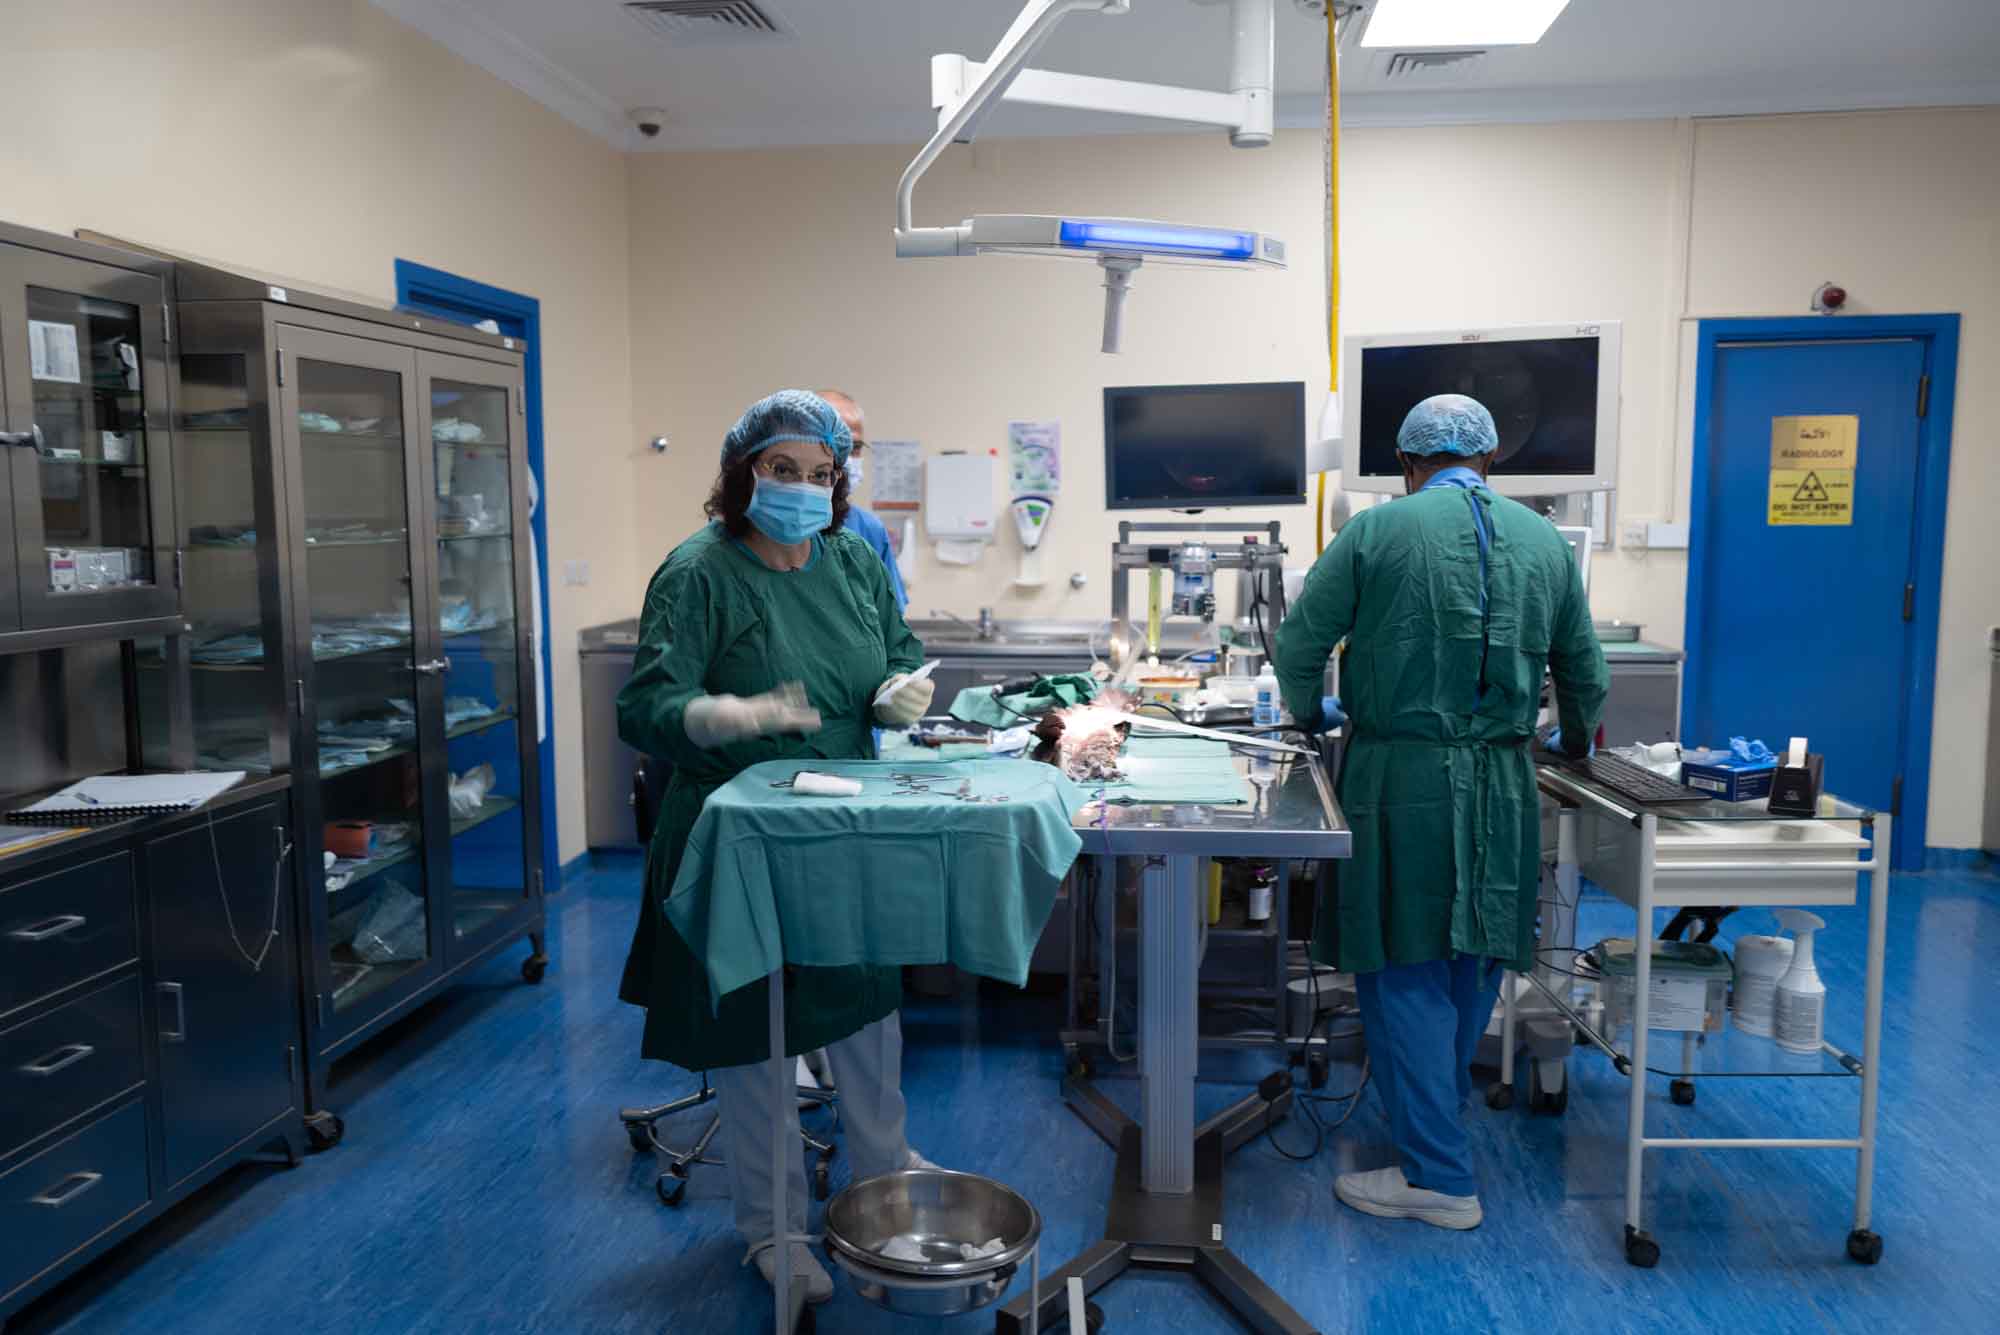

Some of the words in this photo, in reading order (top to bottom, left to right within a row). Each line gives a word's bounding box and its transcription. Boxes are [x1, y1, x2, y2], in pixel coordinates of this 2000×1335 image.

[1781, 448, 1844, 458] RADIOLOGY
[1773, 503, 1787, 511] DO
[1791, 503, 1810, 511] NOT
[1815, 503, 1848, 511] ENTER
